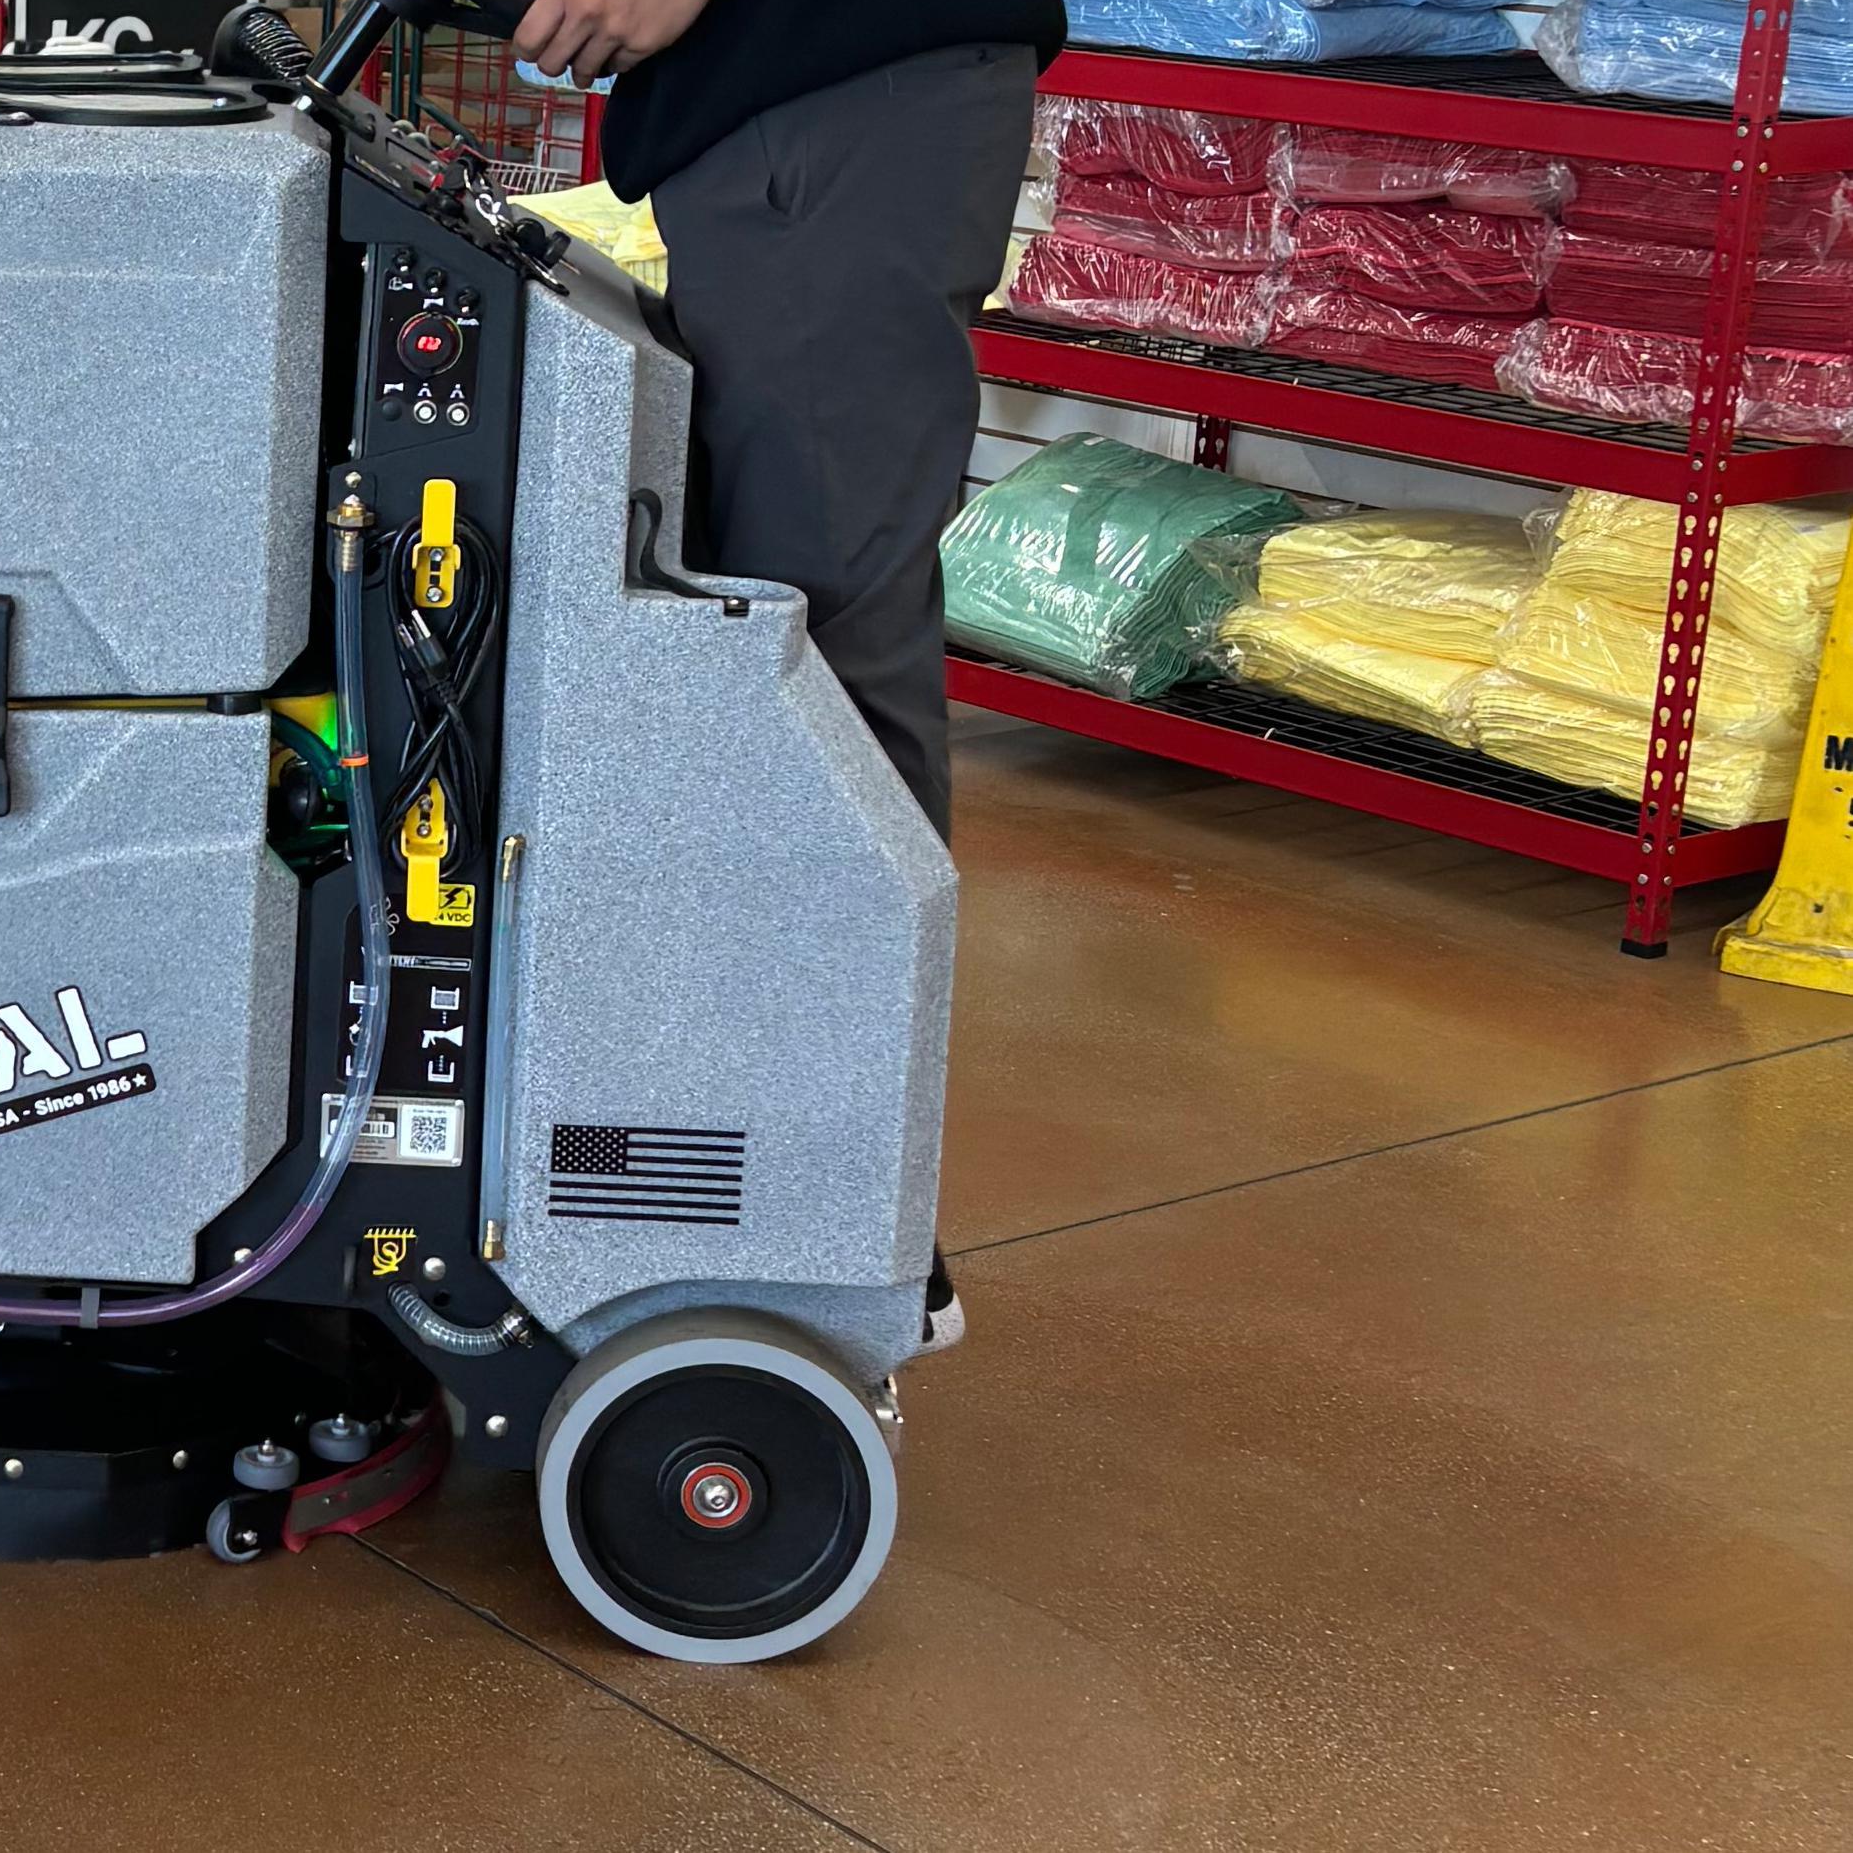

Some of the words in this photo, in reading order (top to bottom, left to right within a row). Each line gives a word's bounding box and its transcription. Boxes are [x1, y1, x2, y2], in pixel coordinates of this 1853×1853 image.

[447, 913, 472, 922] VDC
[34, 1091, 85, 1115] Since
[88, 1076, 132, 1101] 1986
